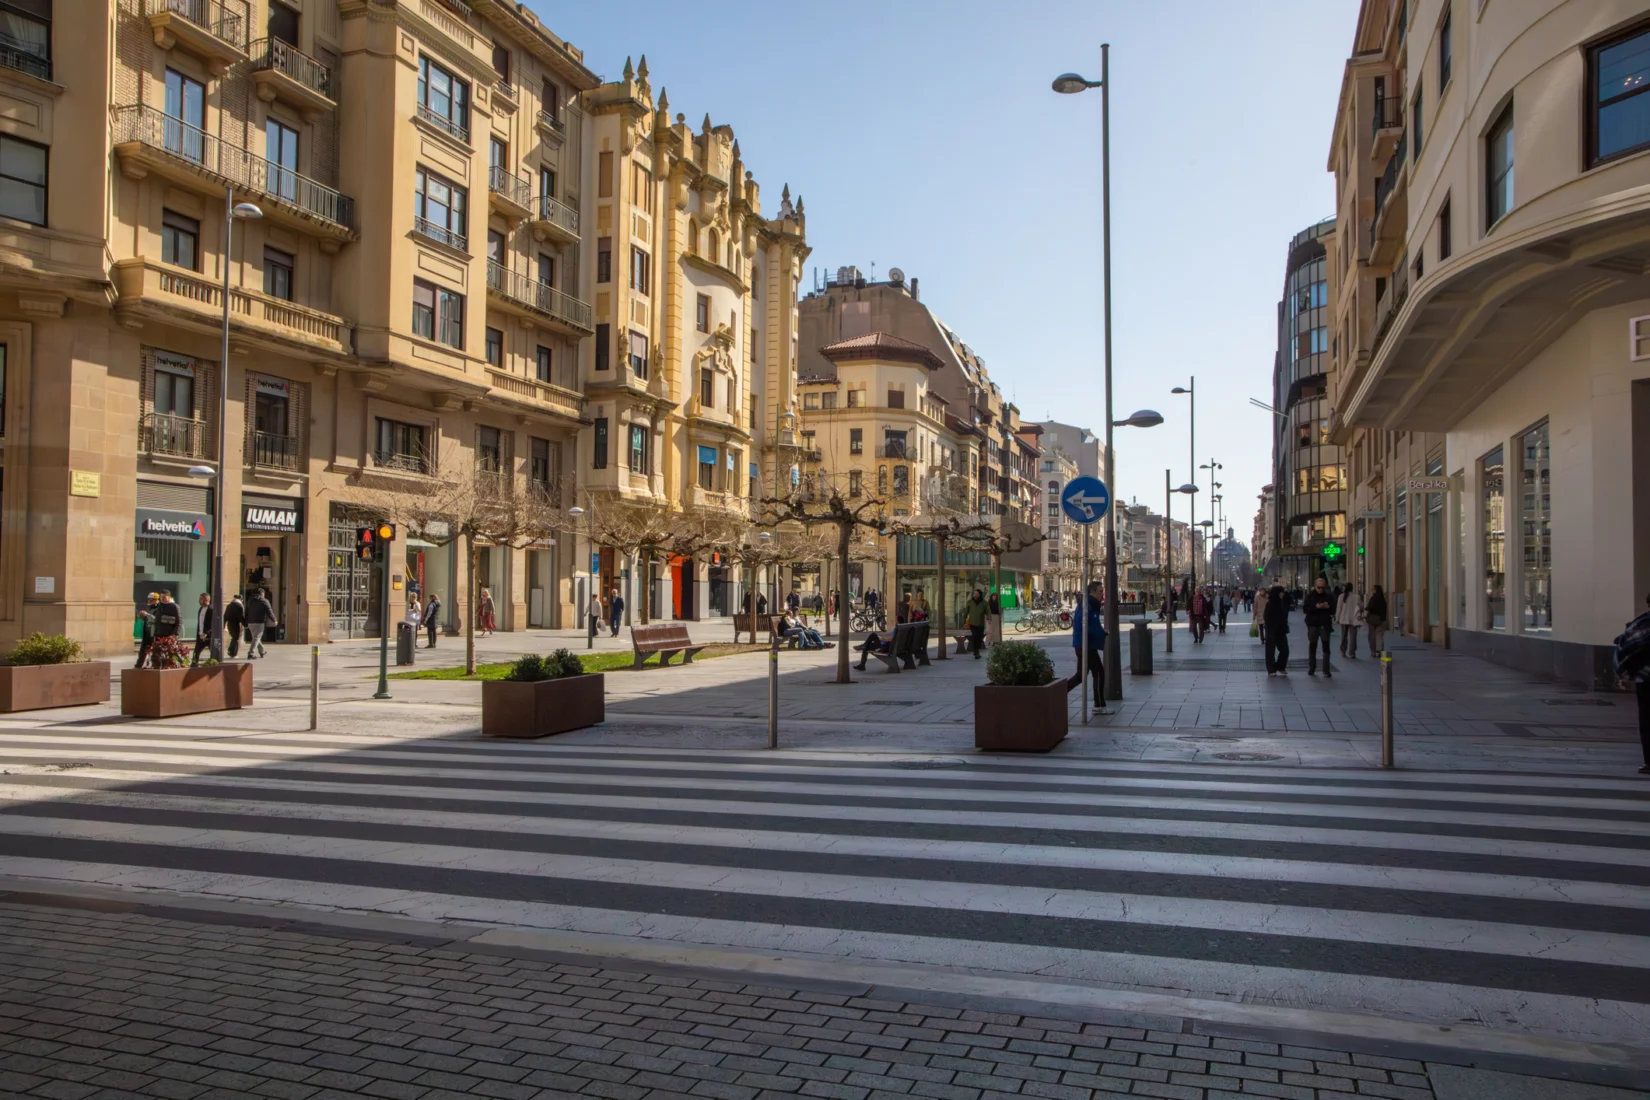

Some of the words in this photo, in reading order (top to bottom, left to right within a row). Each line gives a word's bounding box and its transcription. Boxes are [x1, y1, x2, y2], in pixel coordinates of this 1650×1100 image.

[157, 356, 188, 370] helvetia
[258, 378, 284, 391] helvetia
[1409, 480, 1447, 489] Bershka
[246, 507, 297, 526] IUMAN
[148, 519, 192, 533] helvetia
